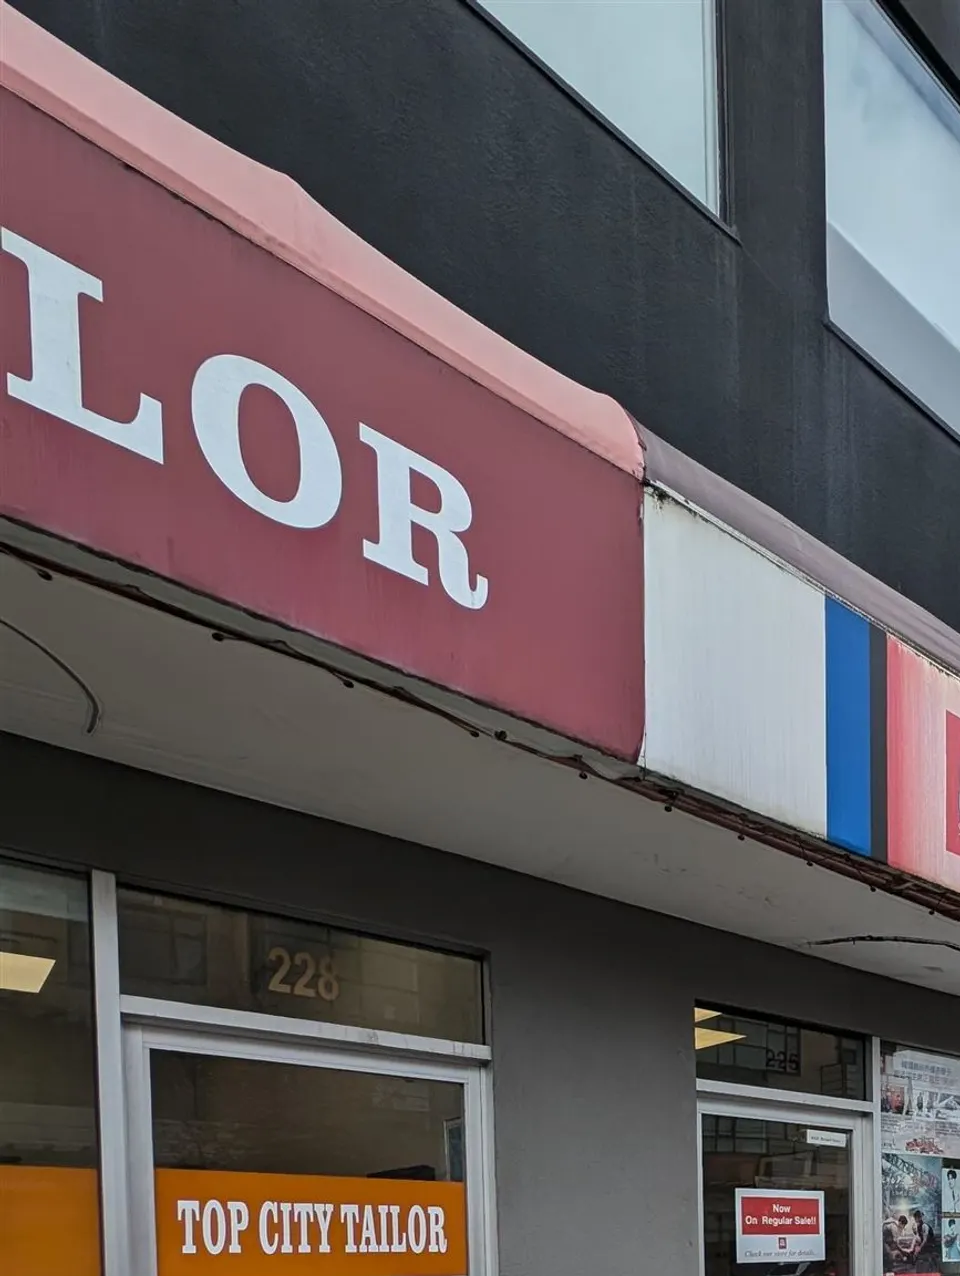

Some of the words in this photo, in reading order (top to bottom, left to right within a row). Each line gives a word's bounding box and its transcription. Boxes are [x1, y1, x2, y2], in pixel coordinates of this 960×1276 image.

[268, 947, 340, 1001] 228
[745, 1215, 758, 1225] On
[762, 1215, 793, 1227] Regular
[794, 1215, 817, 1225] Sale!!
[772, 1203, 791, 1213] Now
[177, 1199, 249, 1255] TOP
[258, 1201, 334, 1255] CITY
[340, 1204, 448, 1254] TAILOR
